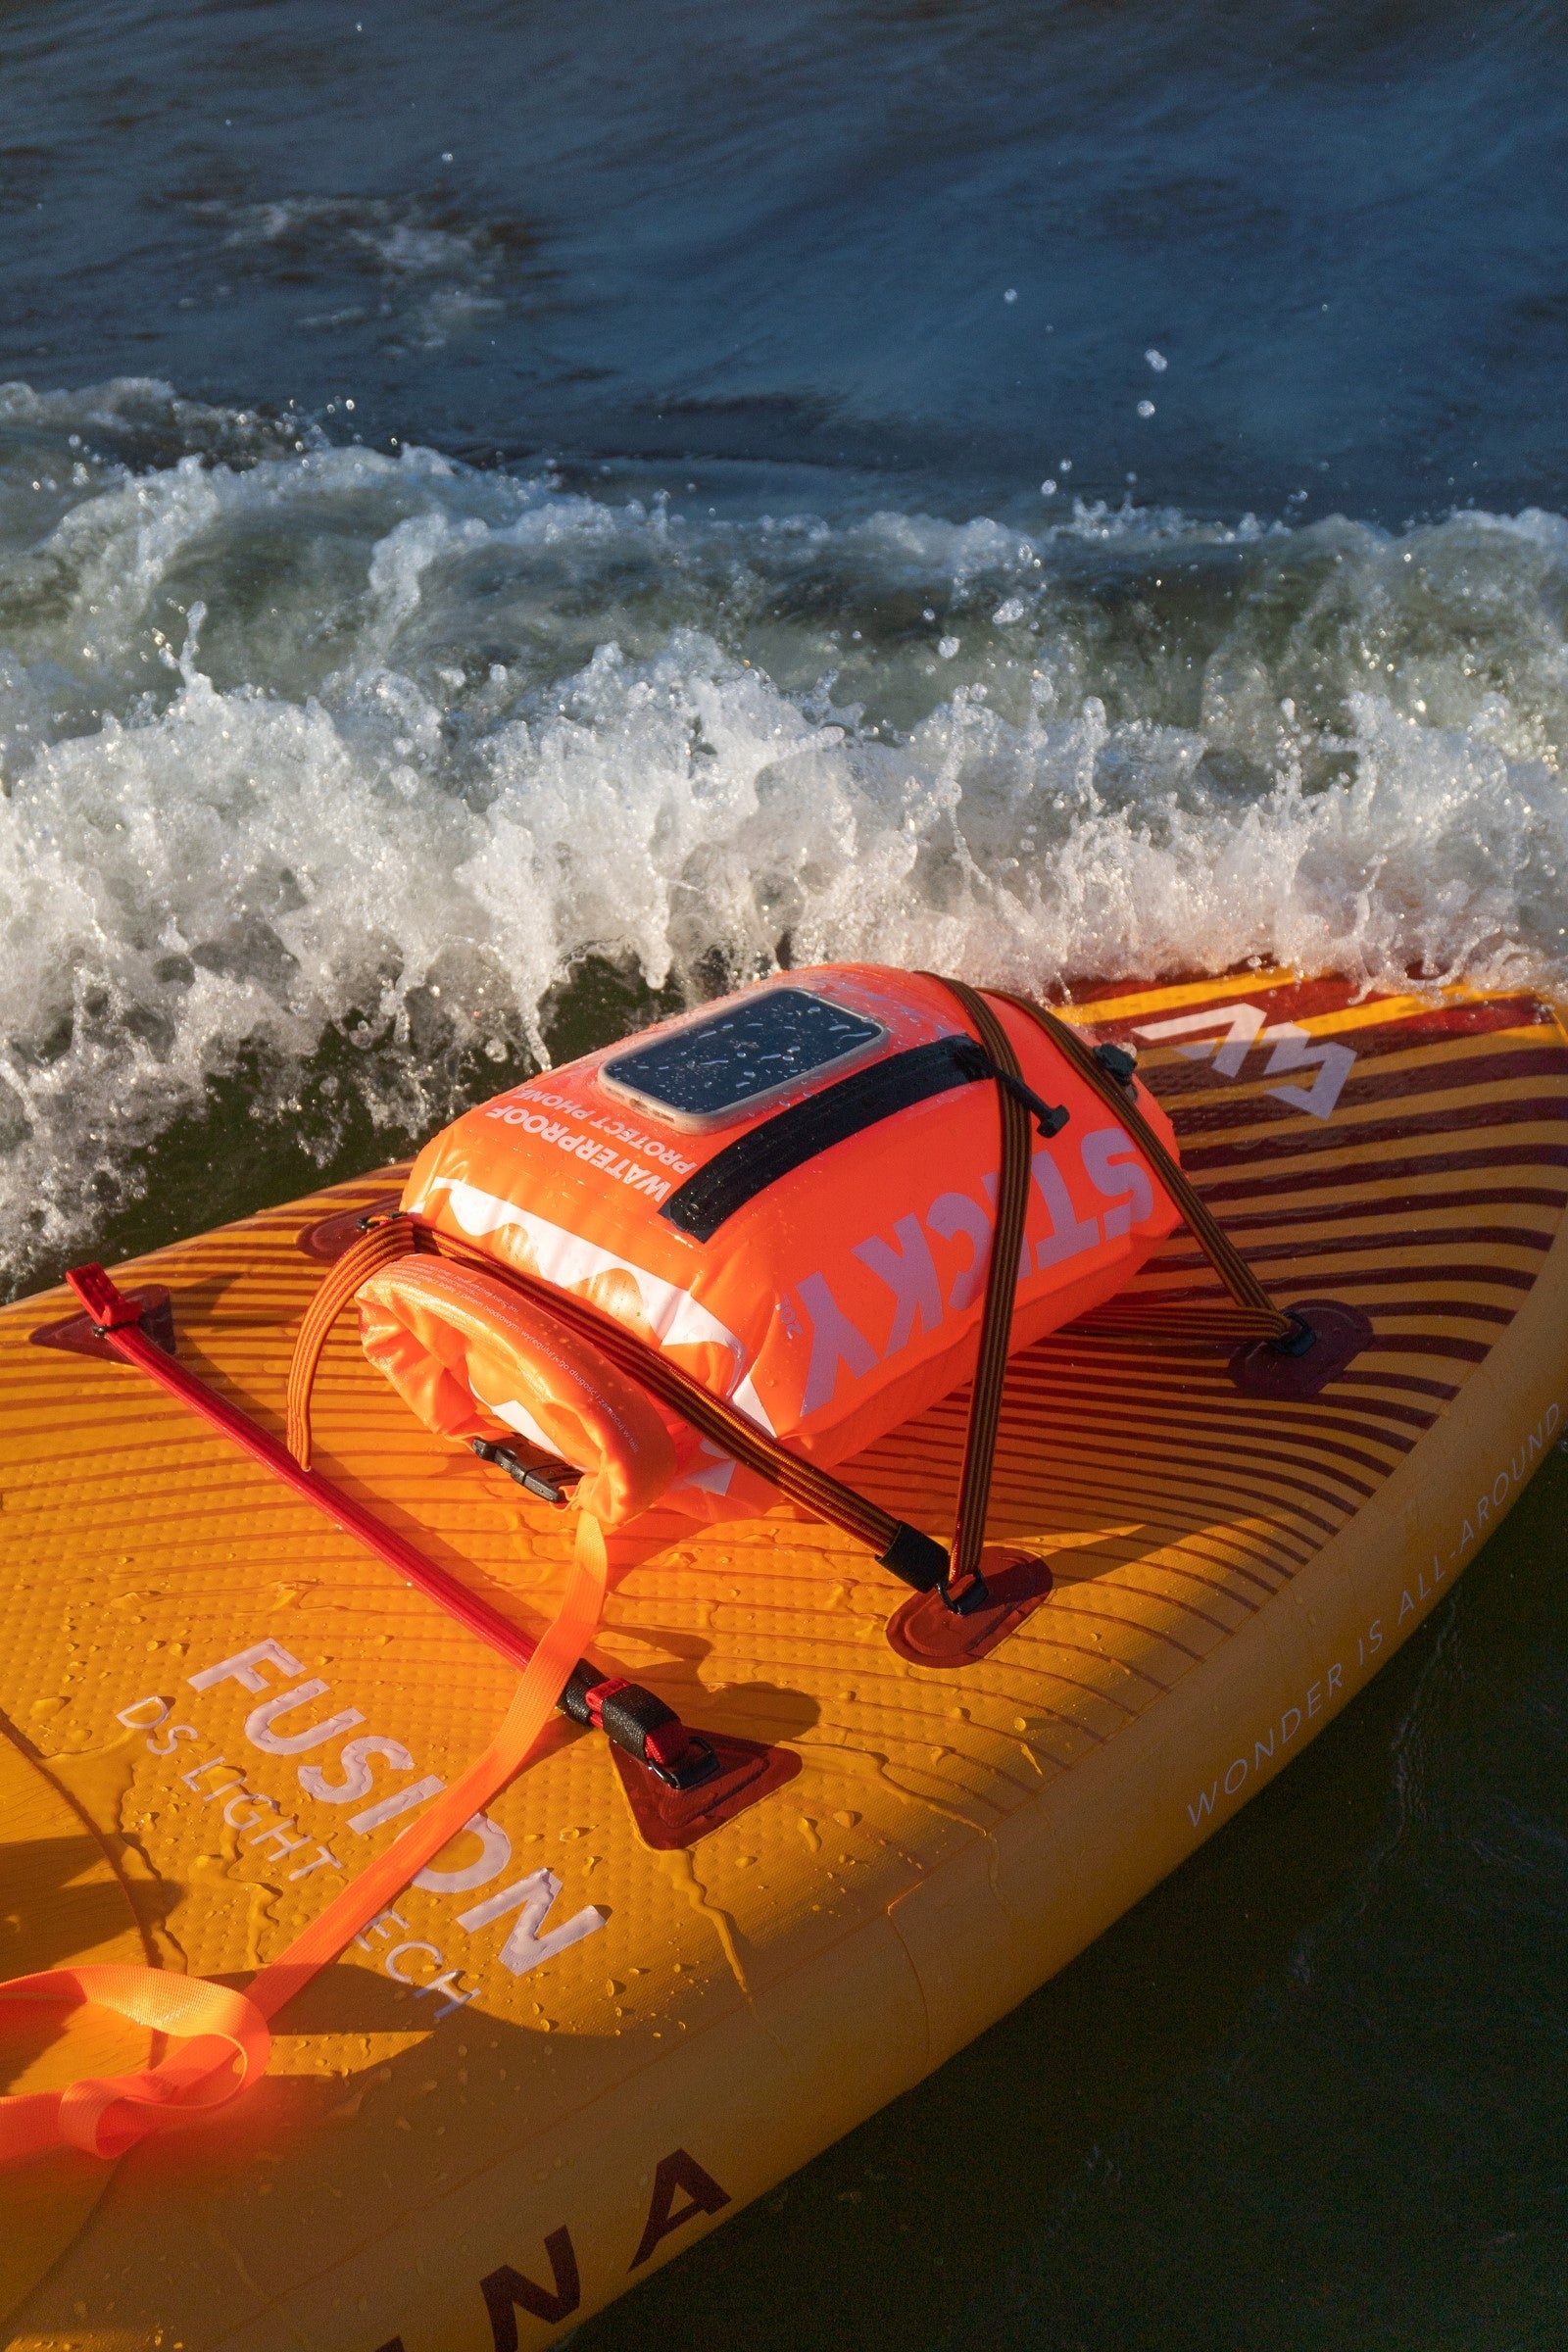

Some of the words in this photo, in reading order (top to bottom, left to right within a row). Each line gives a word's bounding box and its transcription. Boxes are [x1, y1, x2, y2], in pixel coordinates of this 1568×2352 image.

[484, 1104, 672, 1202] WATERPROOF
[513, 1087, 596, 1121] PHONE
[588, 1116, 698, 1175] PROTECT
[1186, 1662, 1345, 1829] WONDER
[1357, 1620, 1384, 1665] IS
[1396, 1402, 1560, 1627] ALL-AROUND
[116, 1695, 199, 1756] DS
[180, 1755, 345, 1882] LIGHT
[352, 1907, 482, 2020] ECH
[186, 1638, 609, 1978] FUSION
